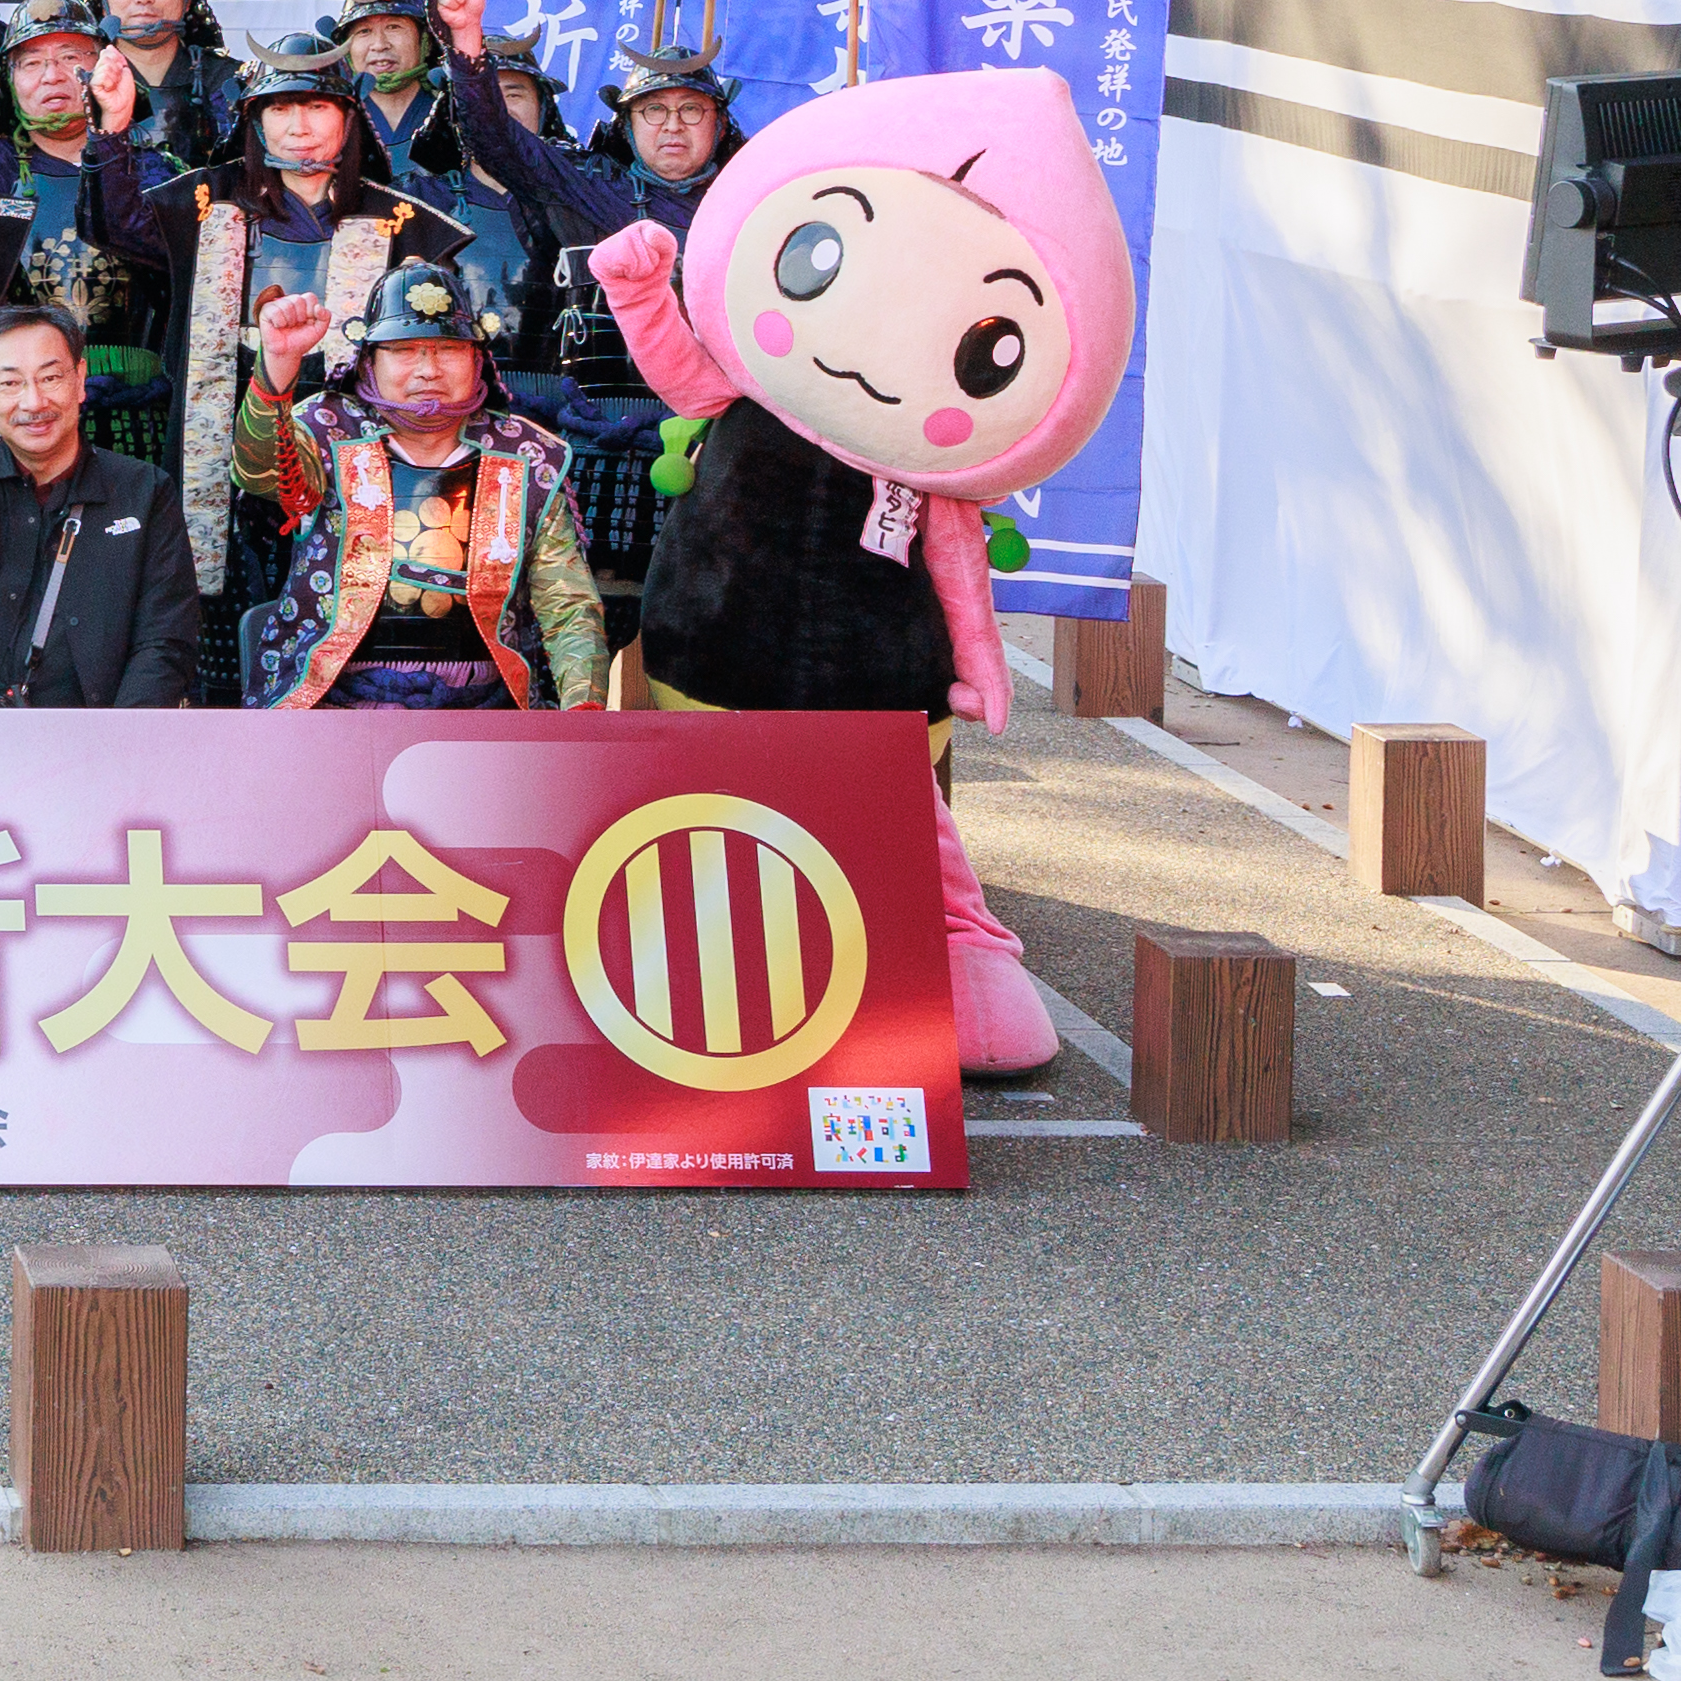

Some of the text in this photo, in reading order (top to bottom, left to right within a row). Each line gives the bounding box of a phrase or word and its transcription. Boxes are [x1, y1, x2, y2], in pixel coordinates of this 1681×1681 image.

[822, 1113, 916, 1142] 実現する
[836, 1144, 909, 1164] ふくしま
